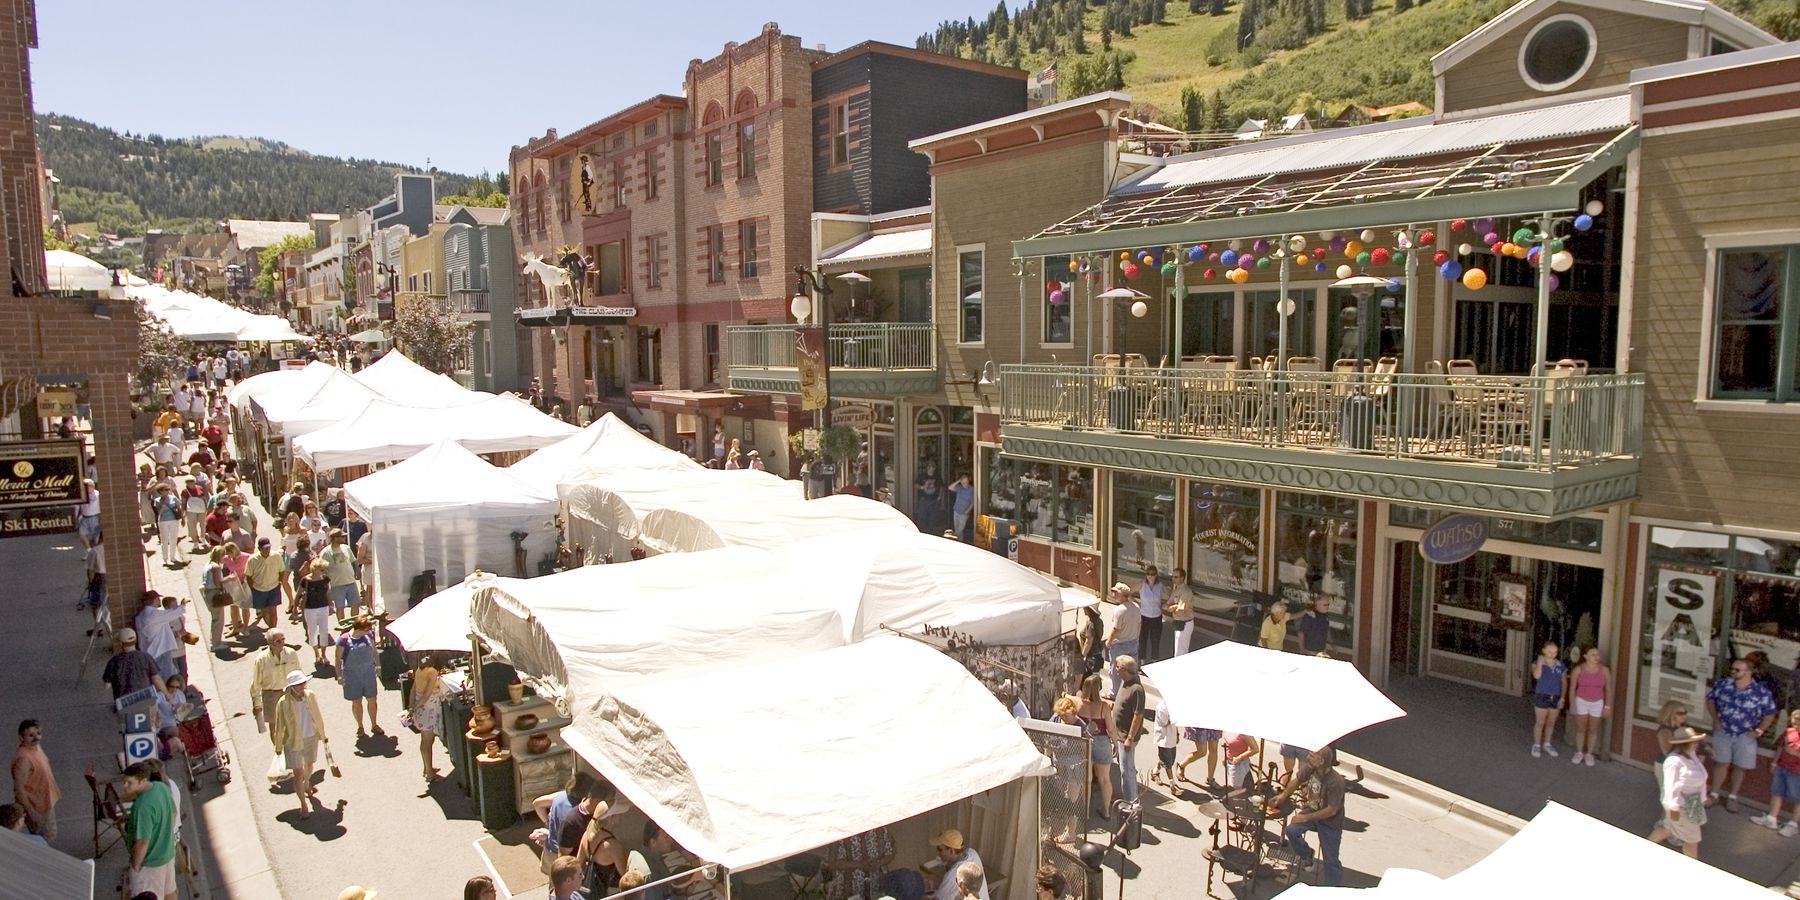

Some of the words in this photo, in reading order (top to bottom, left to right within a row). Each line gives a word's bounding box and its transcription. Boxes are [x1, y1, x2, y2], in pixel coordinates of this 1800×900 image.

[33, 475, 74, 488] Mall
[4, 520, 28, 531] Ski
[30, 516, 73, 529] Rental
[1498, 519, 1515, 529] 577
[1193, 529, 1217, 541] TOURIST
[1218, 528, 1256, 551] INFORMATION
[134, 713, 146, 729] P
[135, 741, 149, 756] P
